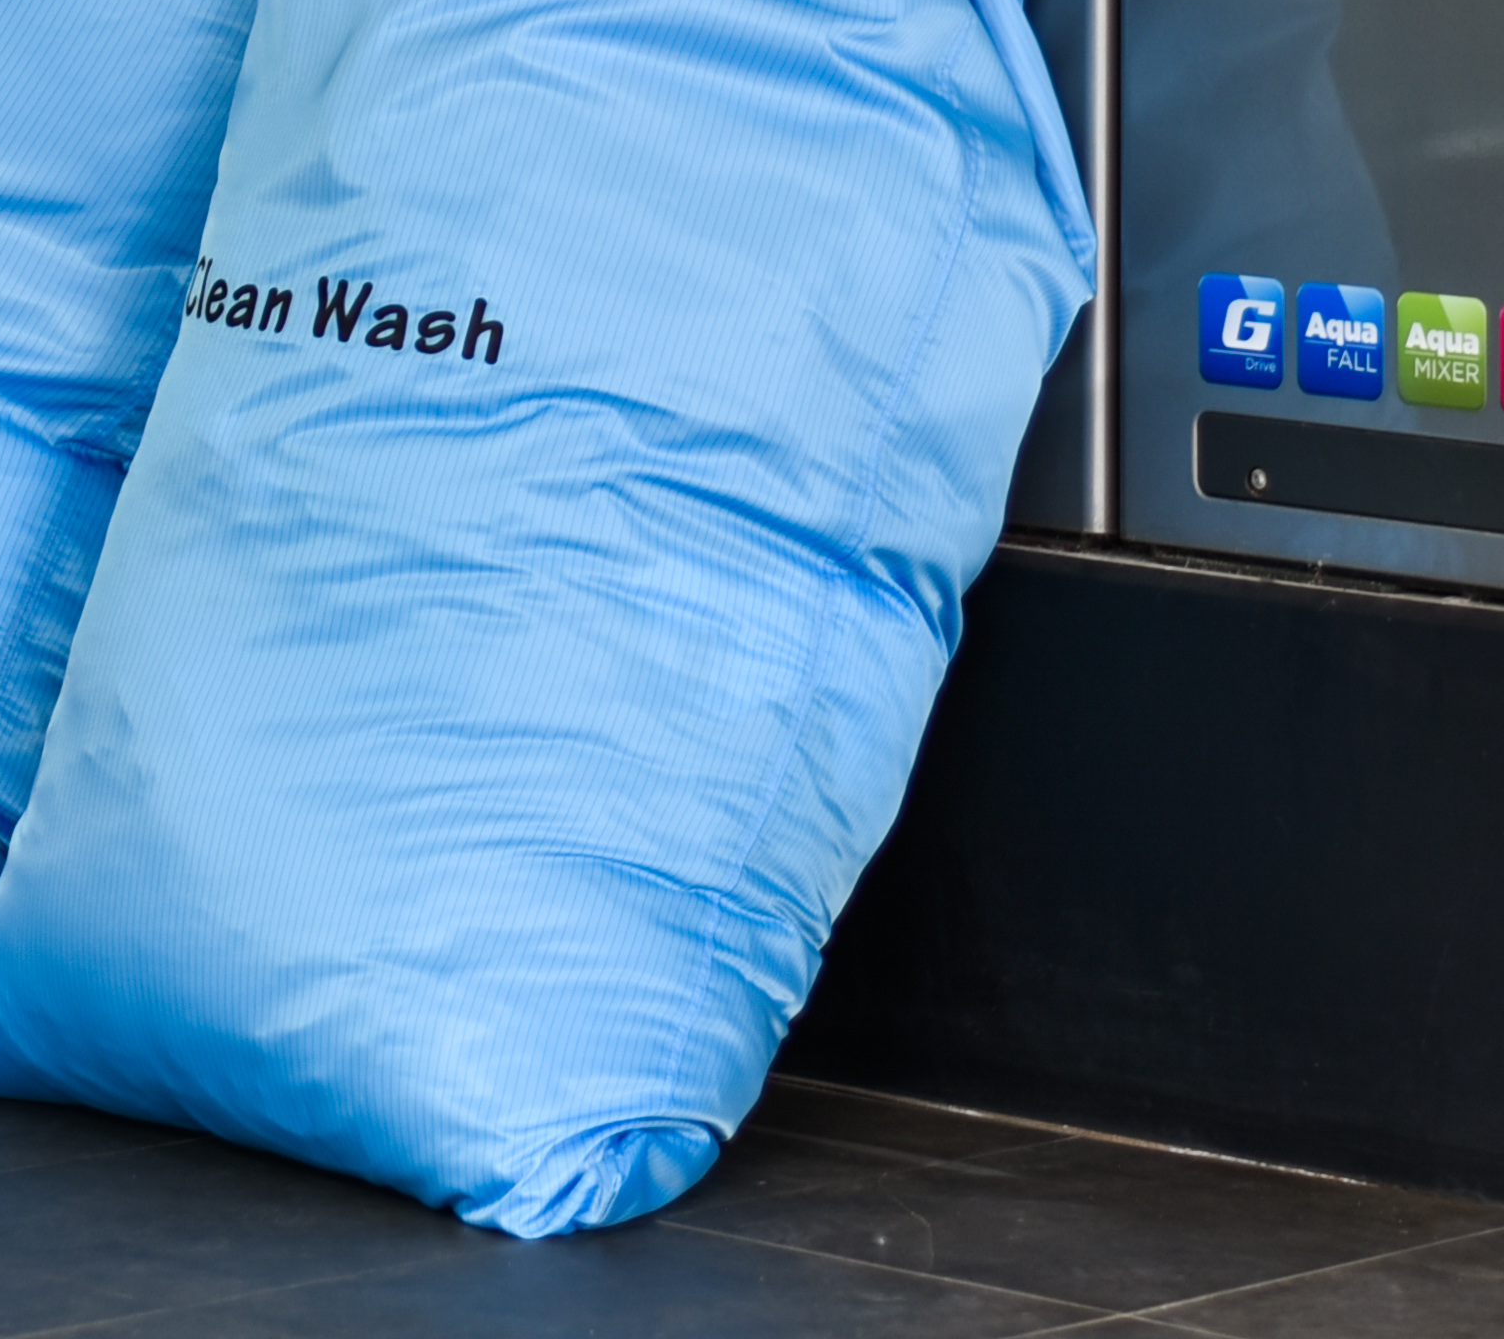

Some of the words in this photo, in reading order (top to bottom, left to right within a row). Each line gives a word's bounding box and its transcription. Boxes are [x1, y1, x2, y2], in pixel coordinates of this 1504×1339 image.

[185, 255, 294, 334] Clean
[312, 275, 505, 366] Wash
[1304, 310, 1380, 353] Aqua
[1404, 322, 1481, 363] Aqua
[1244, 355, 1278, 375] Drive
[1326, 348, 1378, 375] FALL
[1413, 357, 1481, 386] MIXER
